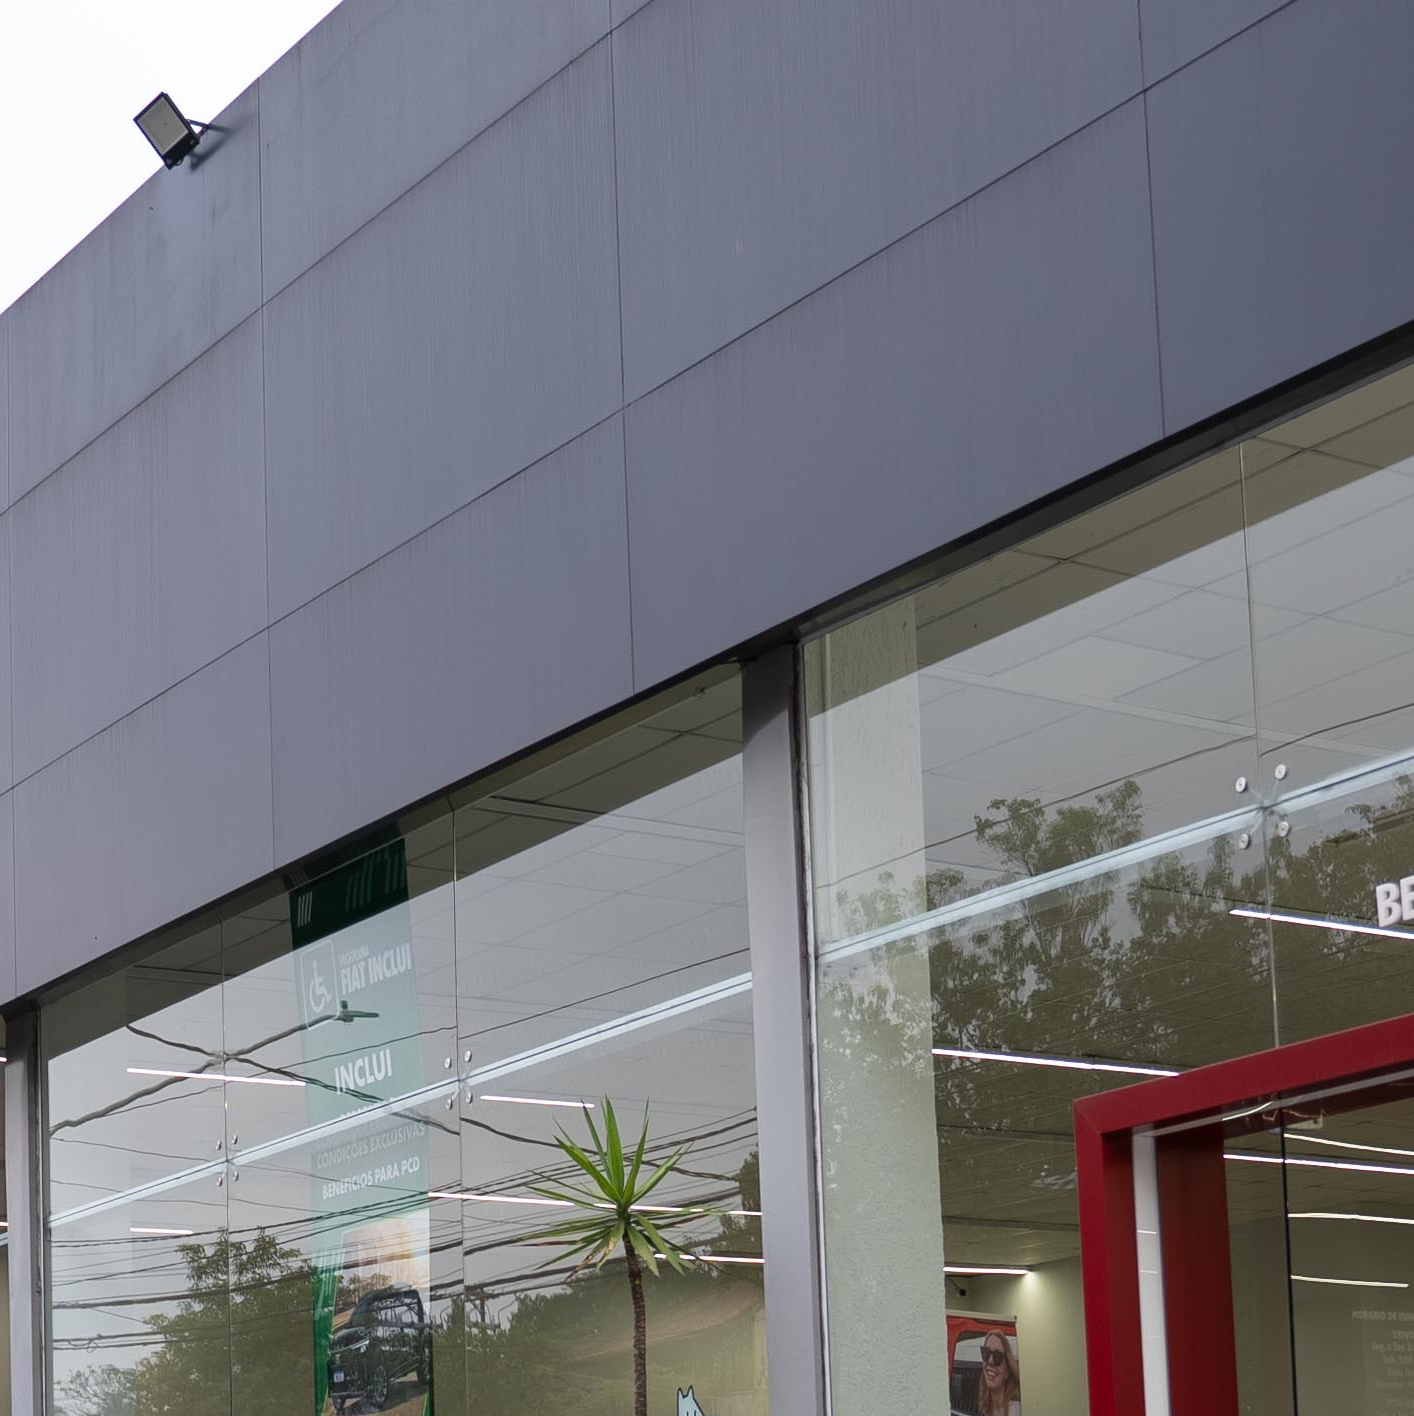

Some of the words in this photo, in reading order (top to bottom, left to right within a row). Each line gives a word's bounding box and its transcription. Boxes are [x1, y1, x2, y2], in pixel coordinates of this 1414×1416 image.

[340, 961, 366, 995] FIAT
[368, 943, 412, 984] INCLUI
[335, 1048, 393, 1094] INCLUI
[370, 1123, 426, 1153] EXCLUSIVAS
[375, 1162, 399, 1188] PARA
[401, 1156, 420, 1176] PCD
